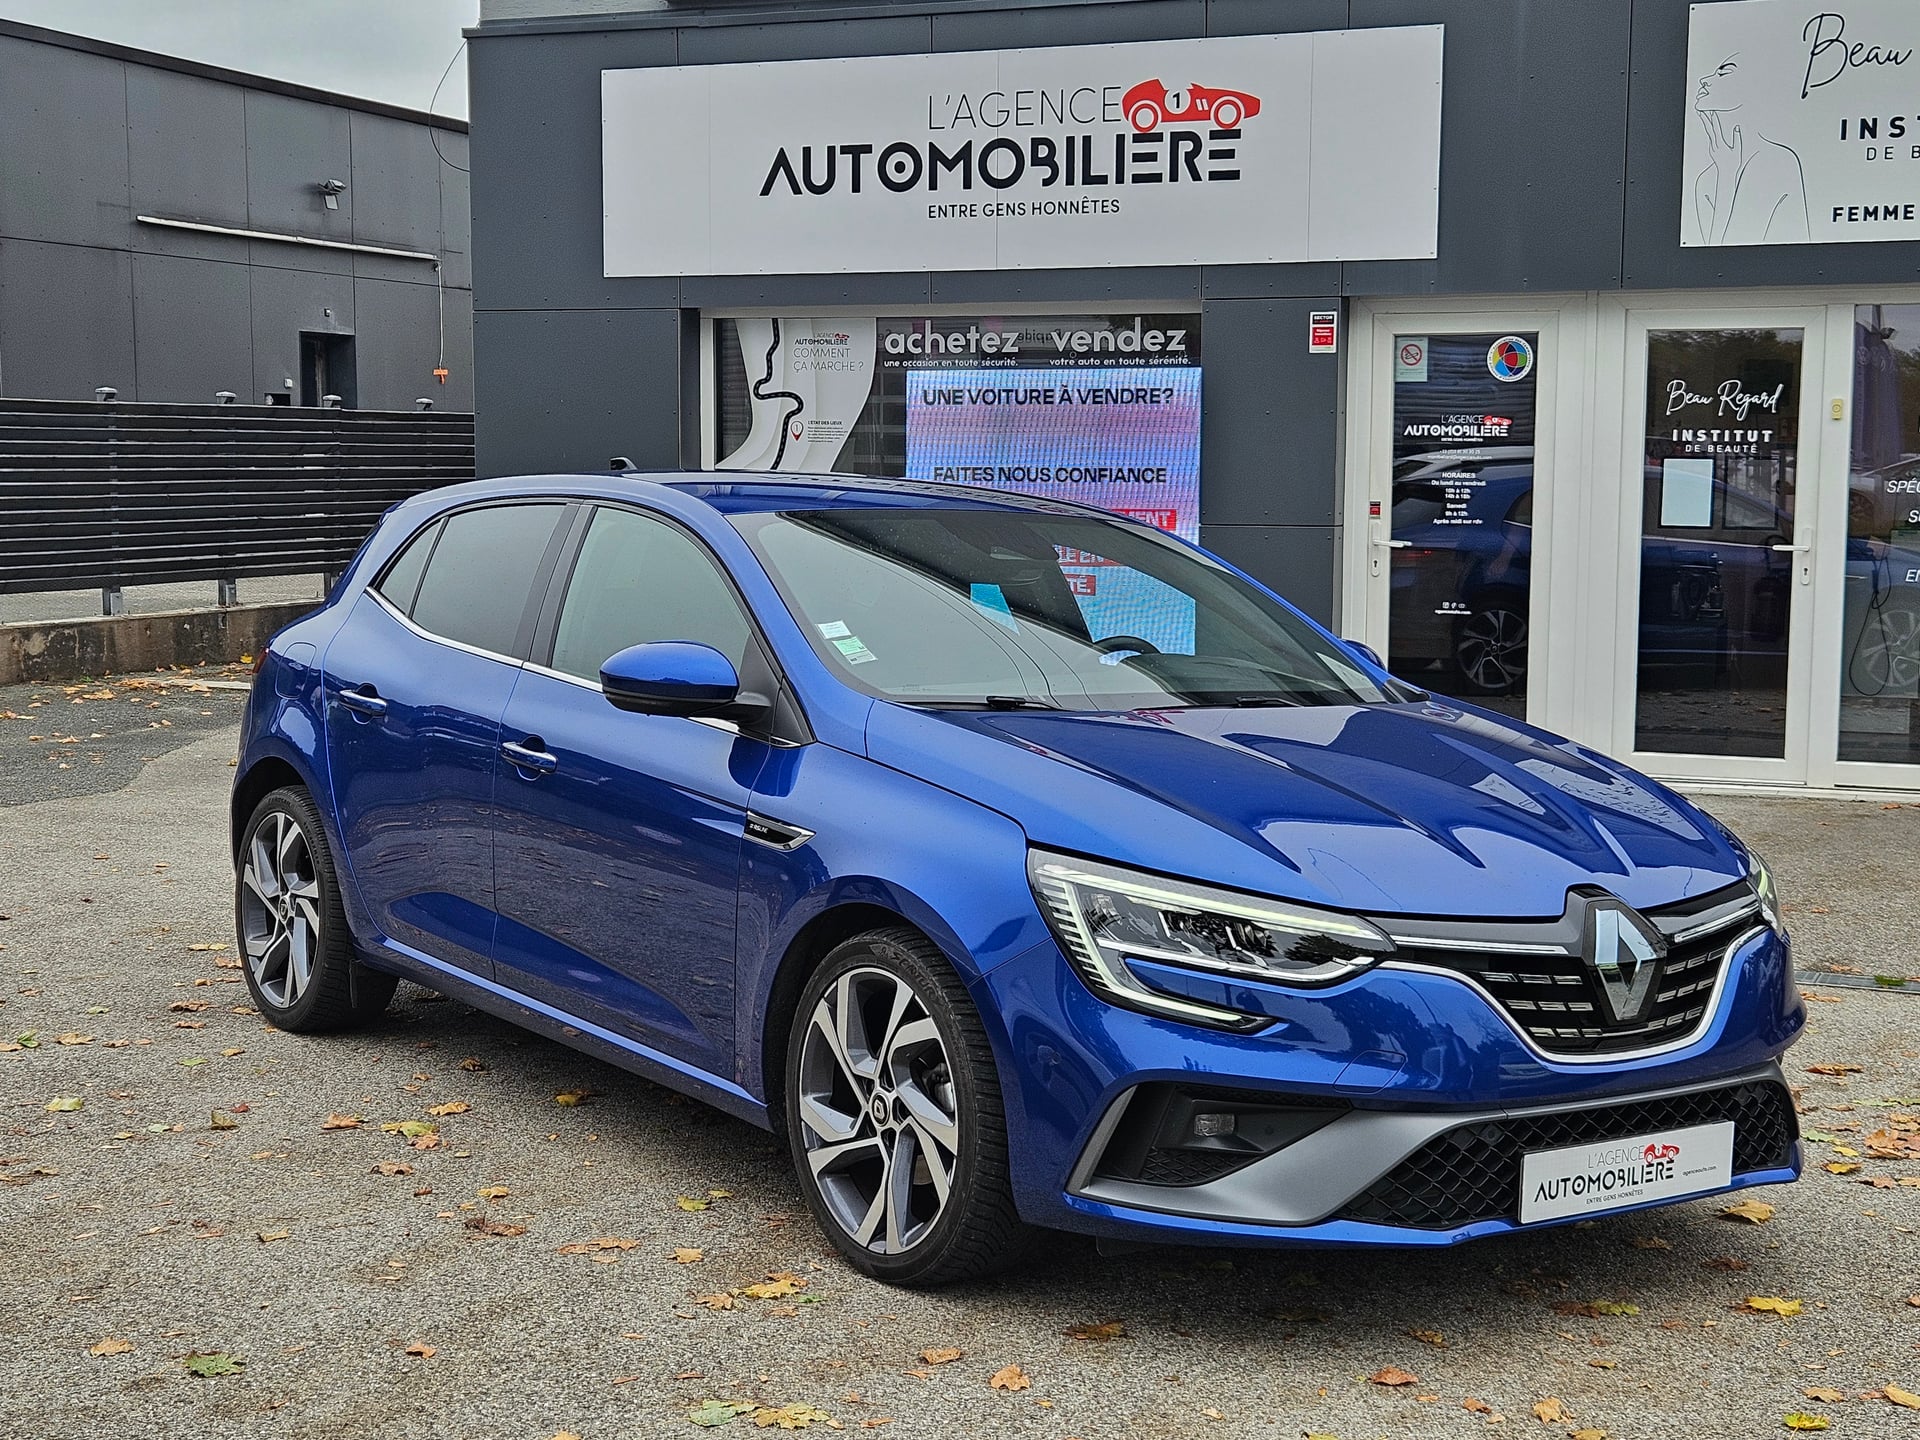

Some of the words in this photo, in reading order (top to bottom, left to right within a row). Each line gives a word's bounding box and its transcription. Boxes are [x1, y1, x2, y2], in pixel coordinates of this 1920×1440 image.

[1802, 12, 1913, 99] Beau
[927, 85, 1122, 130] L'AGENCE
[1172, 92, 1180, 109] 1
[1840, 115, 1920, 140] INS
[1866, 146, 1894, 161] DE
[927, 204, 979, 219] ENTRE
[982, 202, 1026, 217] GENS
[1031, 196, 1121, 216] HONNÊTES
[1832, 204, 1915, 222] FEMME
[884, 319, 1019, 354] achetez
[1050, 316, 1187, 352] vendez
[793, 348, 851, 358] COMMENT
[902, 359, 939, 367] occasion
[954, 358, 979, 367] toute
[981, 356, 1019, 367] sécurité.
[1050, 357, 1076, 366] votre
[1077, 357, 1101, 365] auto
[1119, 357, 1146, 365] toute
[1149, 355, 1192, 365] sérénité.
[793, 361, 807, 374] ÇA
[810, 361, 855, 371] MARCHE
[922, 389, 964, 405] UNE
[968, 388, 1055, 405] VOITURE
[1058, 385, 1073, 404] À
[1076, 388, 1174, 405] VENDRE?
[1666, 379, 1713, 416] Beau
[1717, 379, 1784, 421] Regard
[1672, 429, 1774, 443] INSTITUT
[1685, 444, 1701, 453] DE
[1707, 443, 1759, 453] BEAUTÉ
[933, 466, 995, 482] FAITES
[1000, 467, 1051, 482] NOUS
[1054, 467, 1167, 483] CONFIANCE
[1587, 1145, 1645, 1169] L'AGENCE
[1586, 1195, 1602, 1205] ENTRE
[1604, 1193, 1617, 1202] GENS
